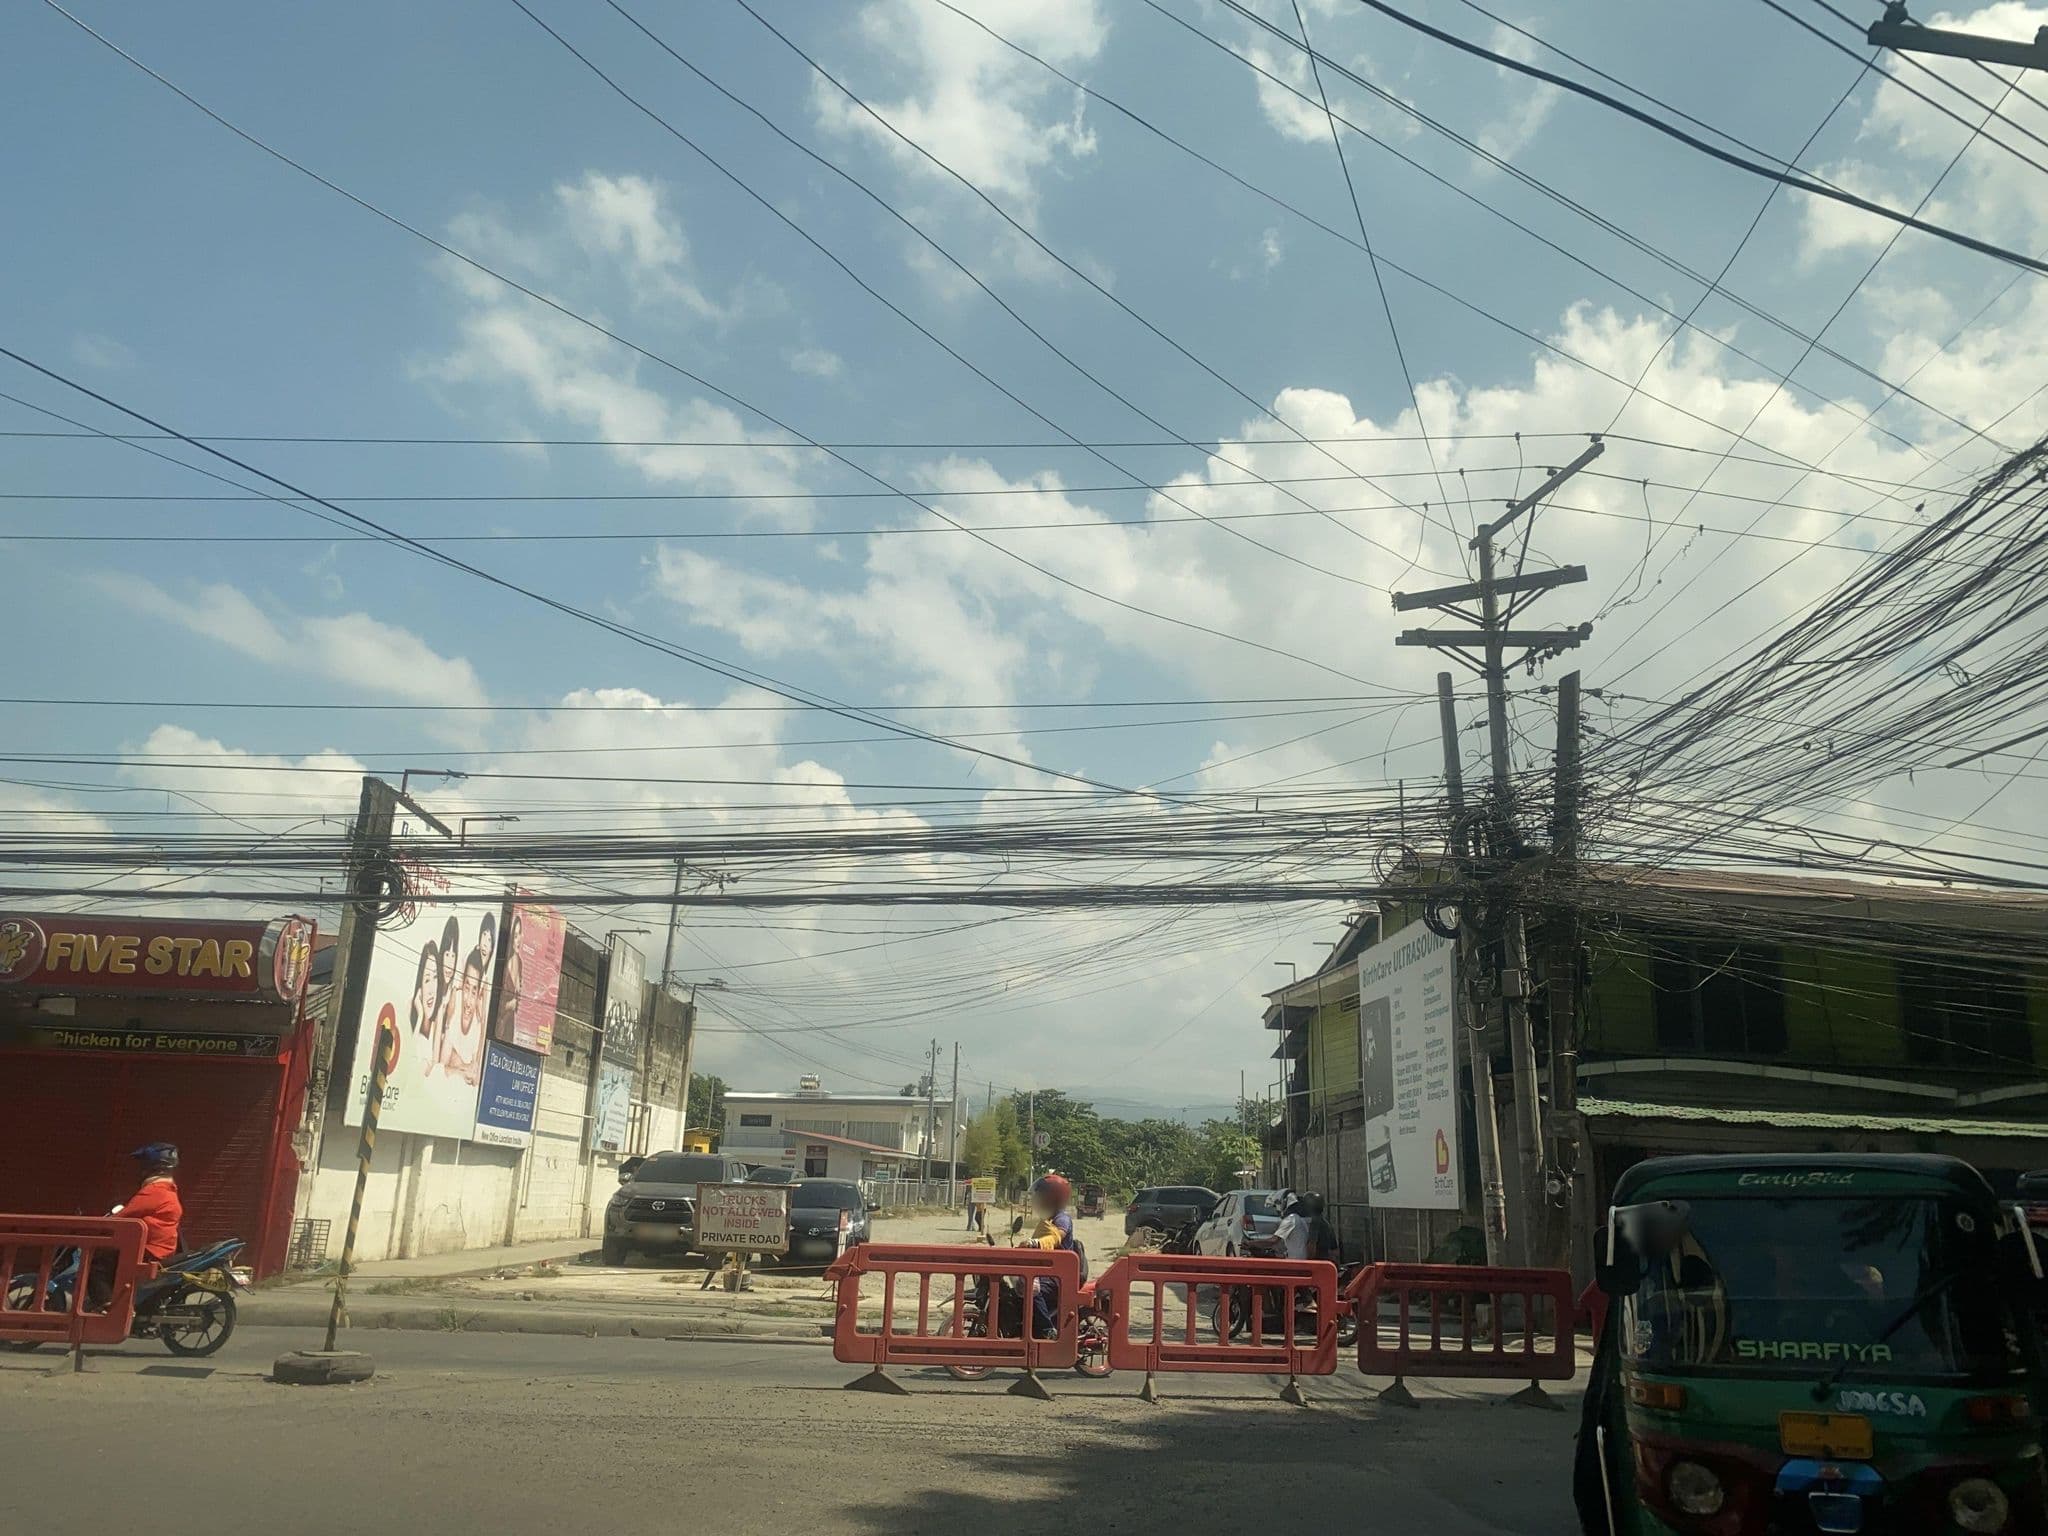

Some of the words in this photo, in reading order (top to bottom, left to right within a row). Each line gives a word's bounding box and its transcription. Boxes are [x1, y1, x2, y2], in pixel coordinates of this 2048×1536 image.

[46, 932, 140, 974] FIVE
[145, 936, 253, 977] STAR
[1362, 960, 1392, 988] BirthCare
[53, 1031, 121, 1049] Chicken
[125, 1034, 151, 1048] for
[155, 1035, 238, 1051] Everyone
[722, 1195, 767, 1206] TRUCKS
[702, 1206, 725, 1217] NOT
[726, 1207, 783, 1219] ALLOWED
[724, 1217, 760, 1229] INSIDE
[701, 1232, 747, 1244] PRIVATE
[749, 1234, 781, 1245] ROAD
[1736, 1339, 1892, 1363] SHARFIYA
